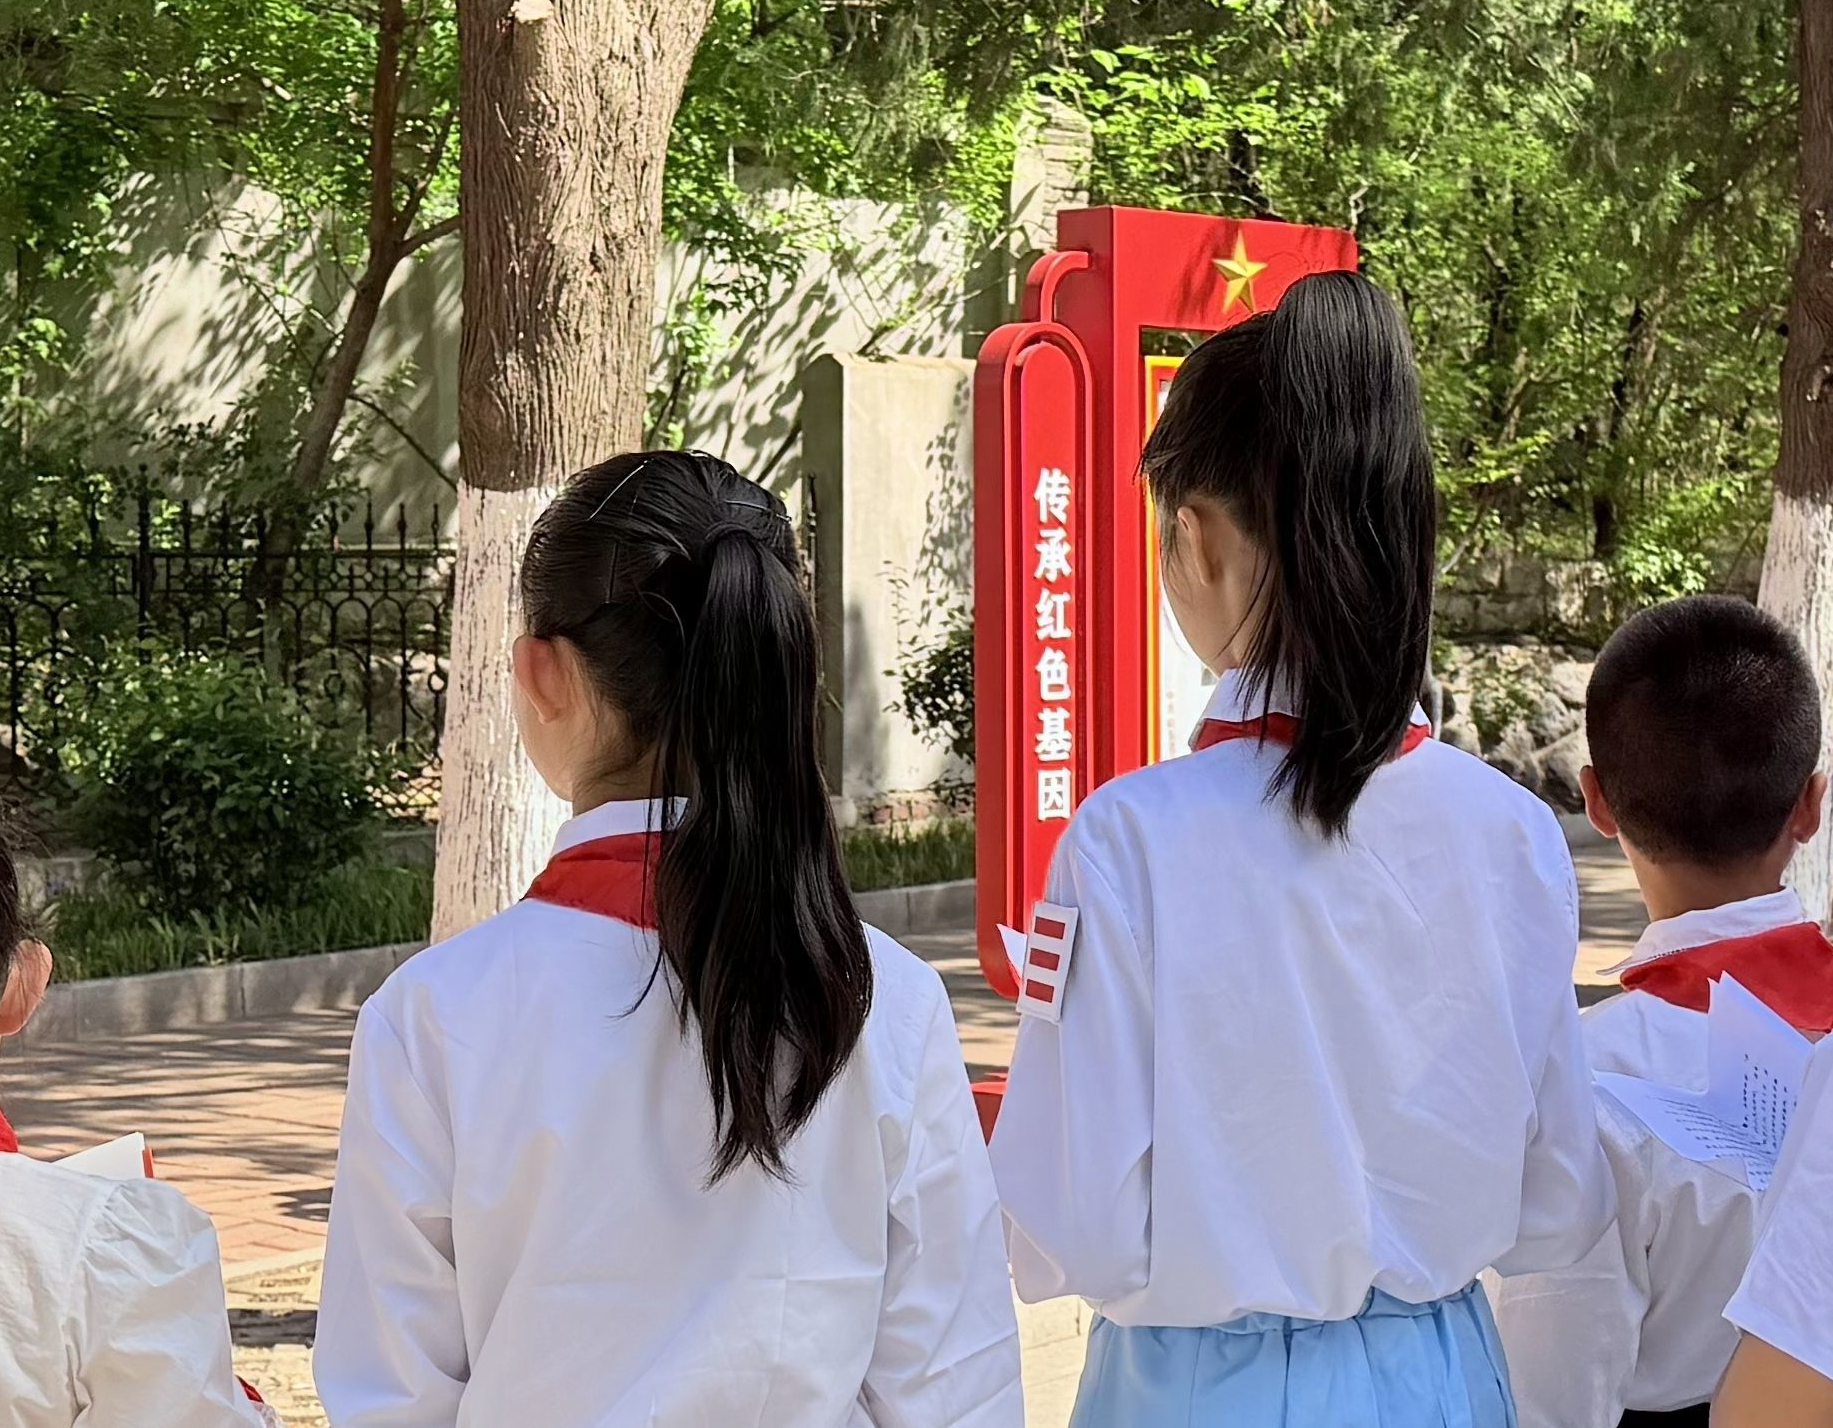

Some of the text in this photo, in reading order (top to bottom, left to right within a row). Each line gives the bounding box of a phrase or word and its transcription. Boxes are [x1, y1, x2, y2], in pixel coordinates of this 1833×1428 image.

[1034, 468, 1072, 822] 传承红色基因
